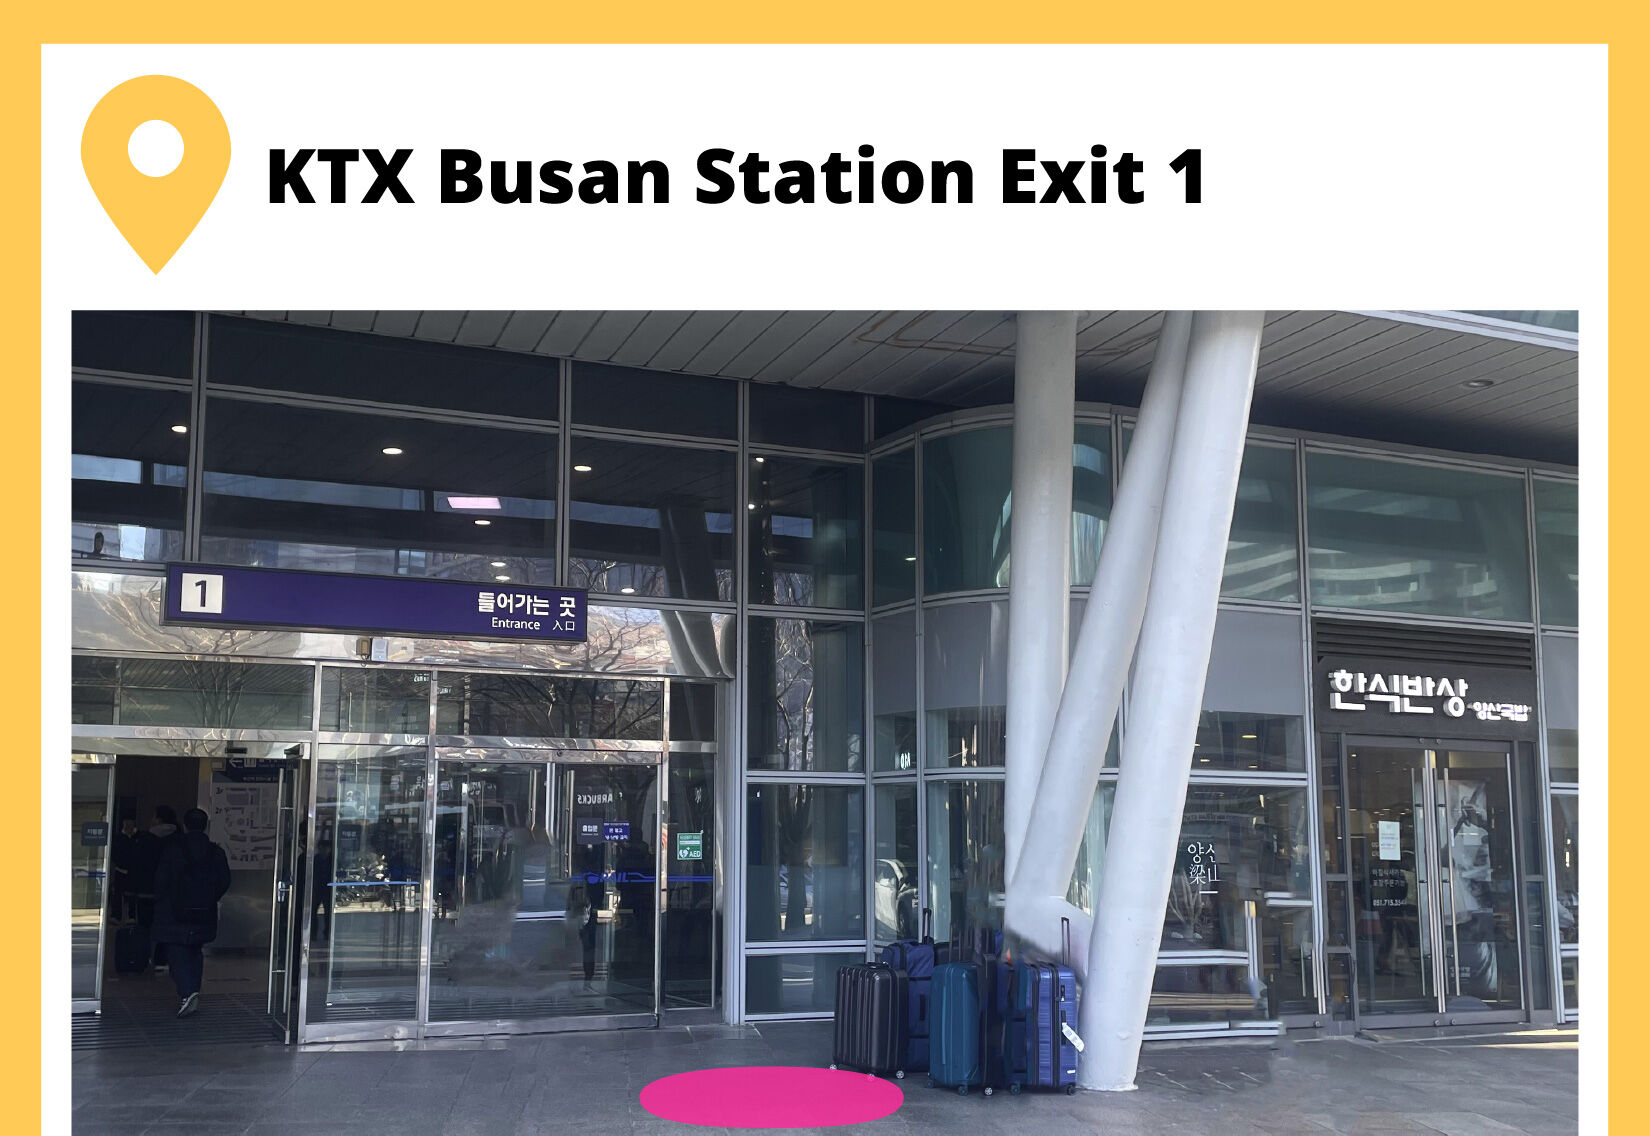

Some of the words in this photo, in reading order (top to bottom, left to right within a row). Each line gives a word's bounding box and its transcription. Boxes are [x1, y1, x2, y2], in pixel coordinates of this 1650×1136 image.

[195, 580, 206, 607] 1
[478, 592, 549, 616] 들어가는
[560, 597, 575, 617] 곳
[492, 617, 540, 630] Entrance
[552, 620, 575, 631] 入口
[1329, 669, 1468, 717] 한식반상
[689, 850, 701, 858] AED
[1187, 841, 1216, 864] 양산
[1189, 863, 1224, 885] 梁山
